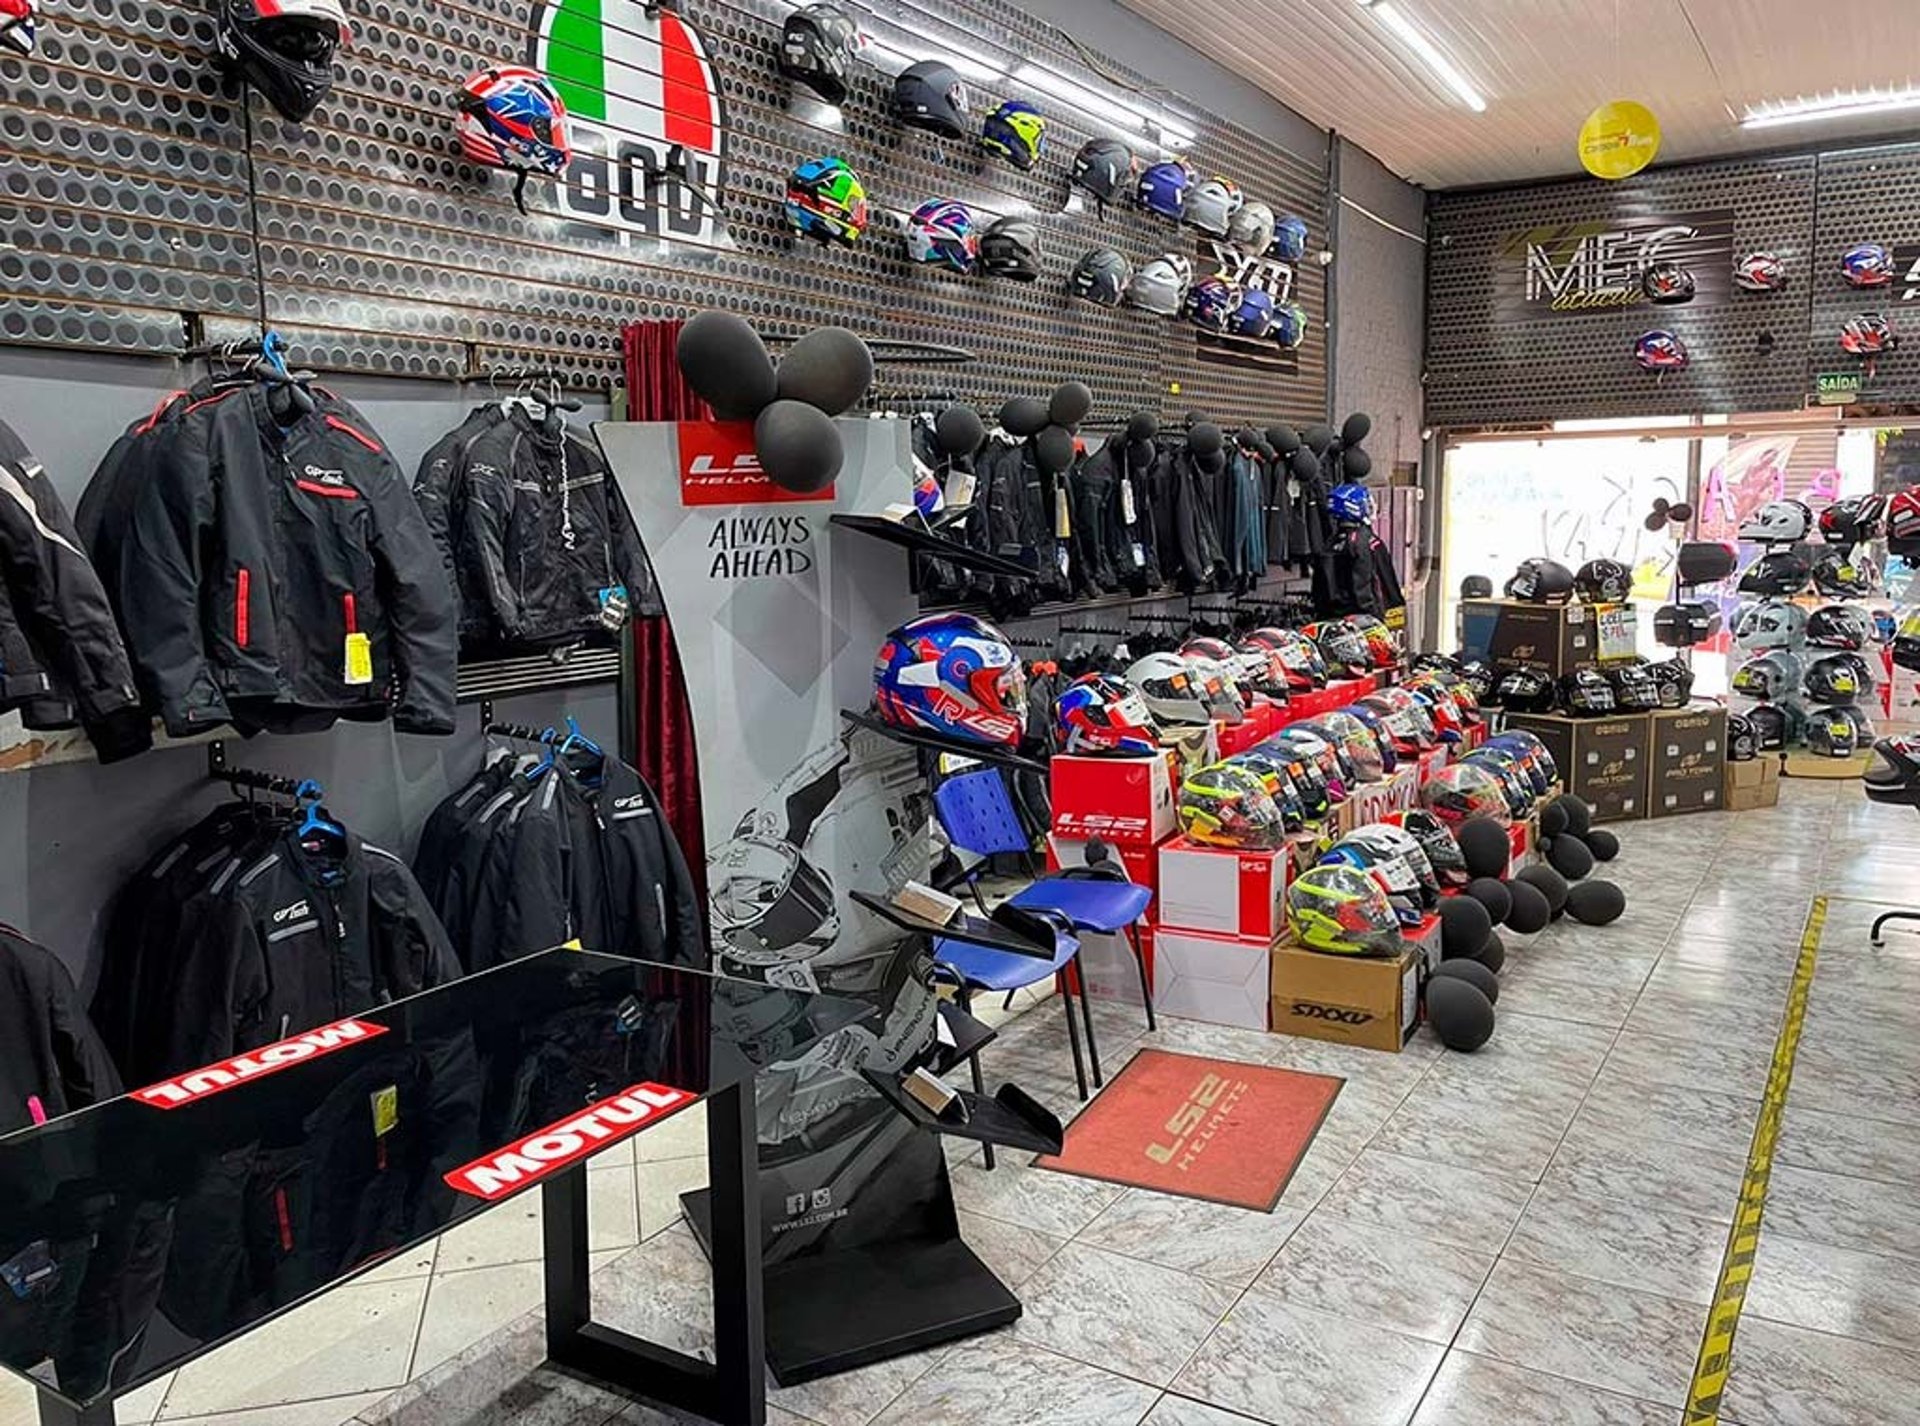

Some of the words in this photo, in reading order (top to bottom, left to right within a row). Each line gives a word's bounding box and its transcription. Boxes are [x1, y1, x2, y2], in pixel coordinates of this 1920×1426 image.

[686, 476, 771, 485] HELM
[689, 455, 765, 474] LS
[708, 517, 809, 550] ALWAYS
[710, 549, 811, 579] AHEAD
[1057, 812, 1148, 831] LS2
[144, 1020, 369, 1102] MOTUL
[1145, 1072, 1230, 1165] LS2
[1177, 1080, 1249, 1171] HELMETS
[464, 1088, 683, 1195] MOTUL
